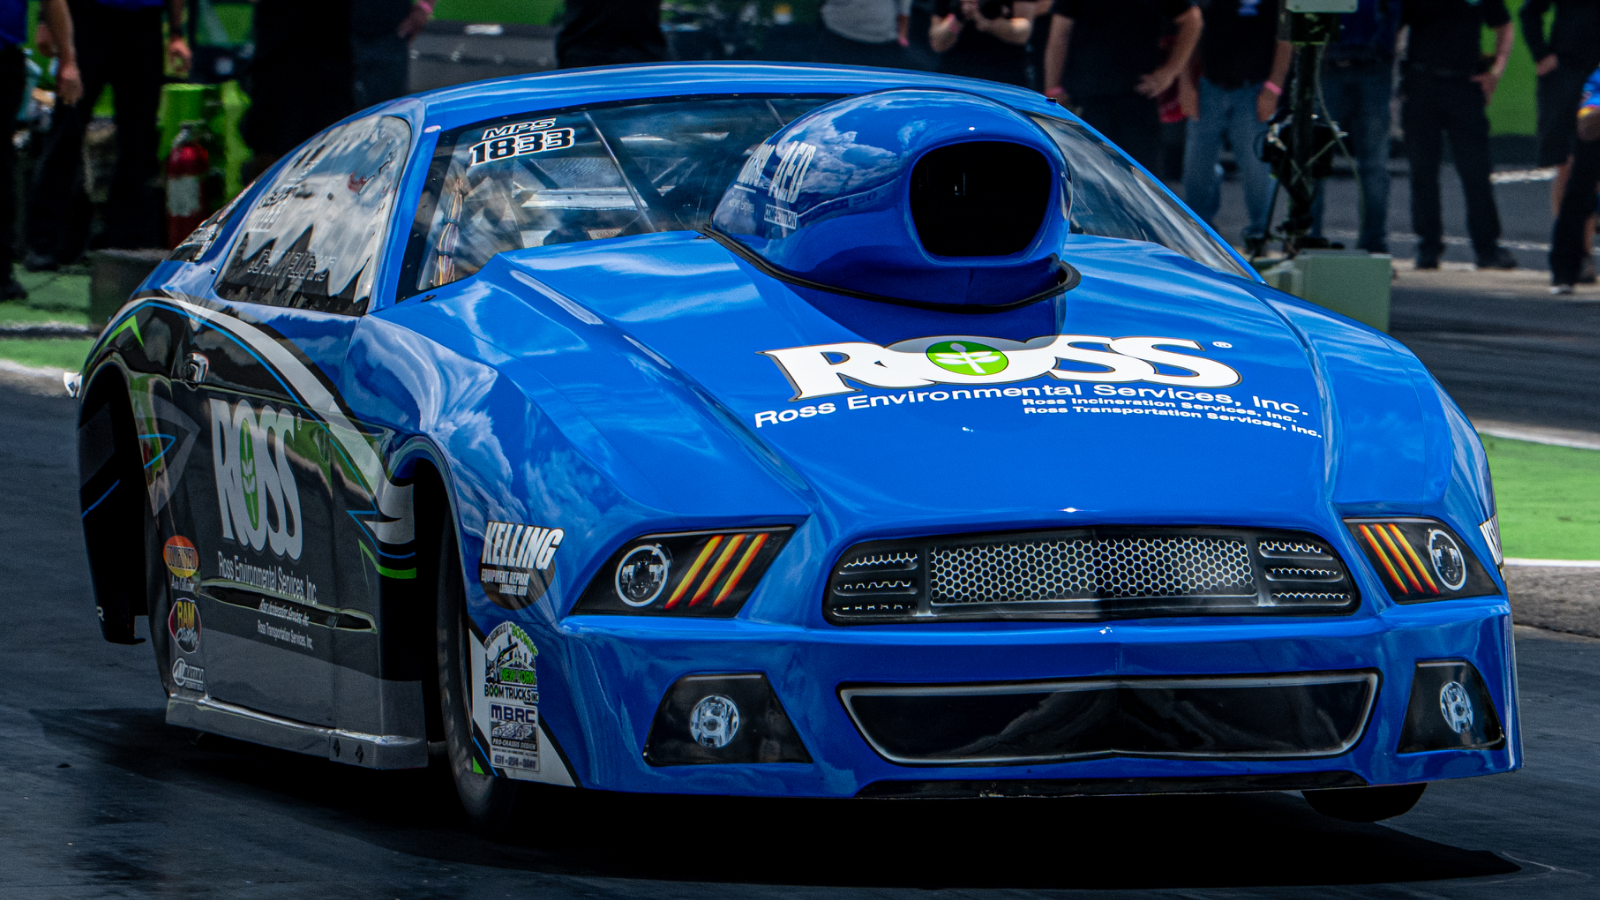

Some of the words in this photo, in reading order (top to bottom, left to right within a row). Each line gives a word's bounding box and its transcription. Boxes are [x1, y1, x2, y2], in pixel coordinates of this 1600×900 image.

[482, 118, 556, 140] MPS
[469, 128, 575, 166] 1833
[755, 335, 1242, 402] ROSS
[754, 402, 836, 428] Ross
[847, 384, 1082, 410] Environmental
[1093, 384, 1241, 407] Services,
[1252, 395, 1309, 416] Inc.
[1022, 398, 1066, 406] Ross
[1072, 397, 1174, 409] Incineration
[1181, 402, 1262, 417] Services,
[1266, 411, 1298, 422] Inc.
[1073, 406, 1202, 418] Transportation
[1207, 412, 1288, 430] Services,
[1292, 424, 1323, 438] Inc.
[209, 398, 304, 560] ROSS
[481, 521, 564, 570] KELLING
[217, 551, 234, 580] Ross
[234, 555, 277, 592] Environmental
[277, 566, 304, 605] Services,
[176, 601, 196, 630] RAM
[501, 667, 516, 682] NEW
[517, 669, 535, 685] YORK
[484, 683, 505, 698] BOOM
[505, 687, 531, 702] TRUCKS
[491, 704, 535, 724] MBRC
